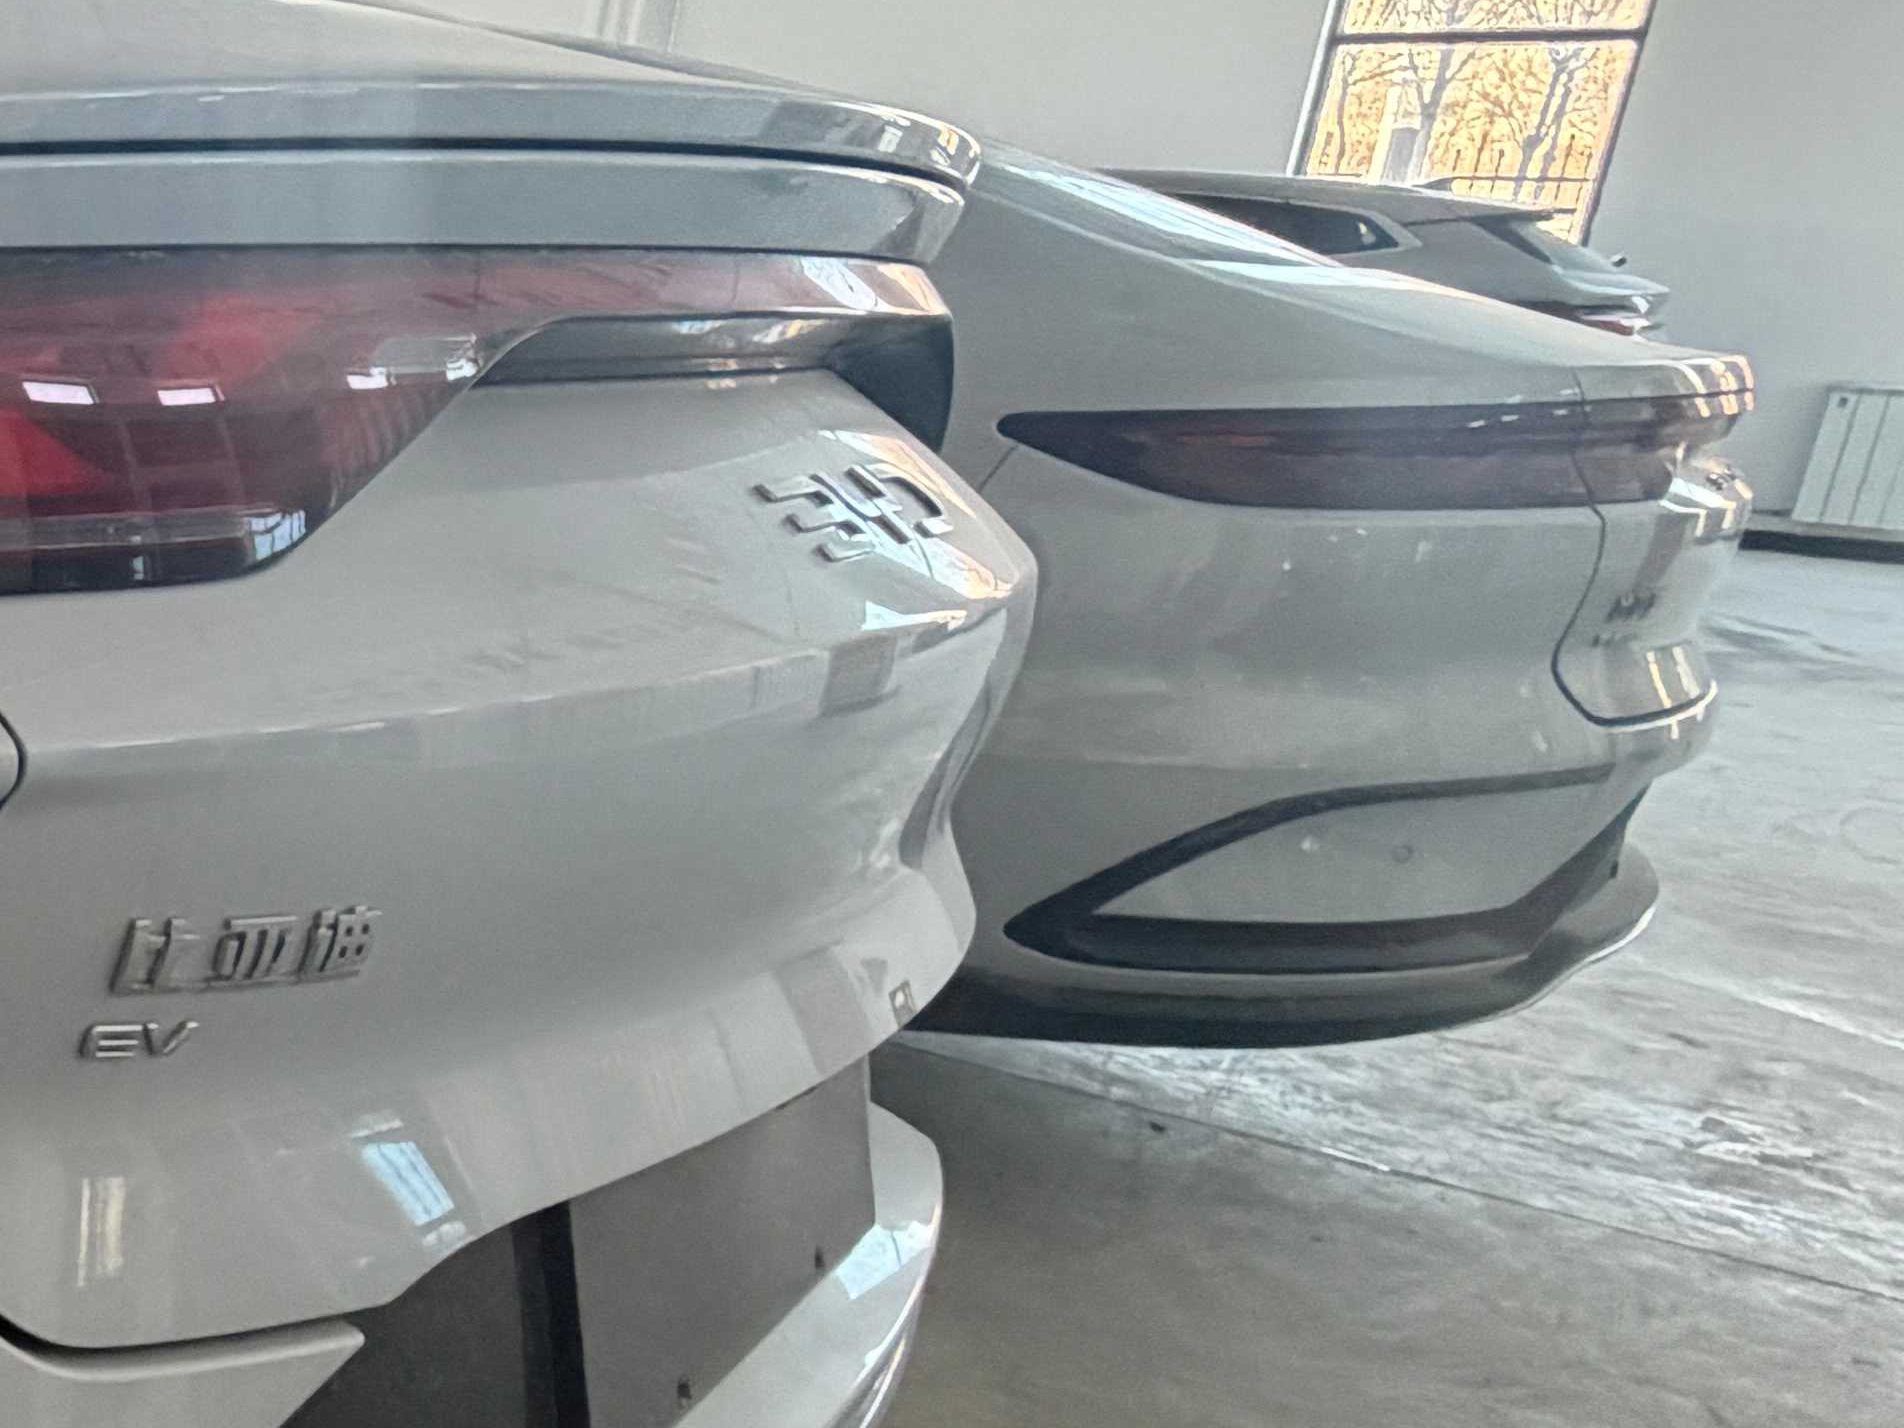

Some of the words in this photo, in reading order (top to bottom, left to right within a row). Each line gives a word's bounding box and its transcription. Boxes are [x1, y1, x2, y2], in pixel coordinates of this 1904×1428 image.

[108, 906, 382, 995] 比亚迪
[77, 1021, 199, 1058] EV
